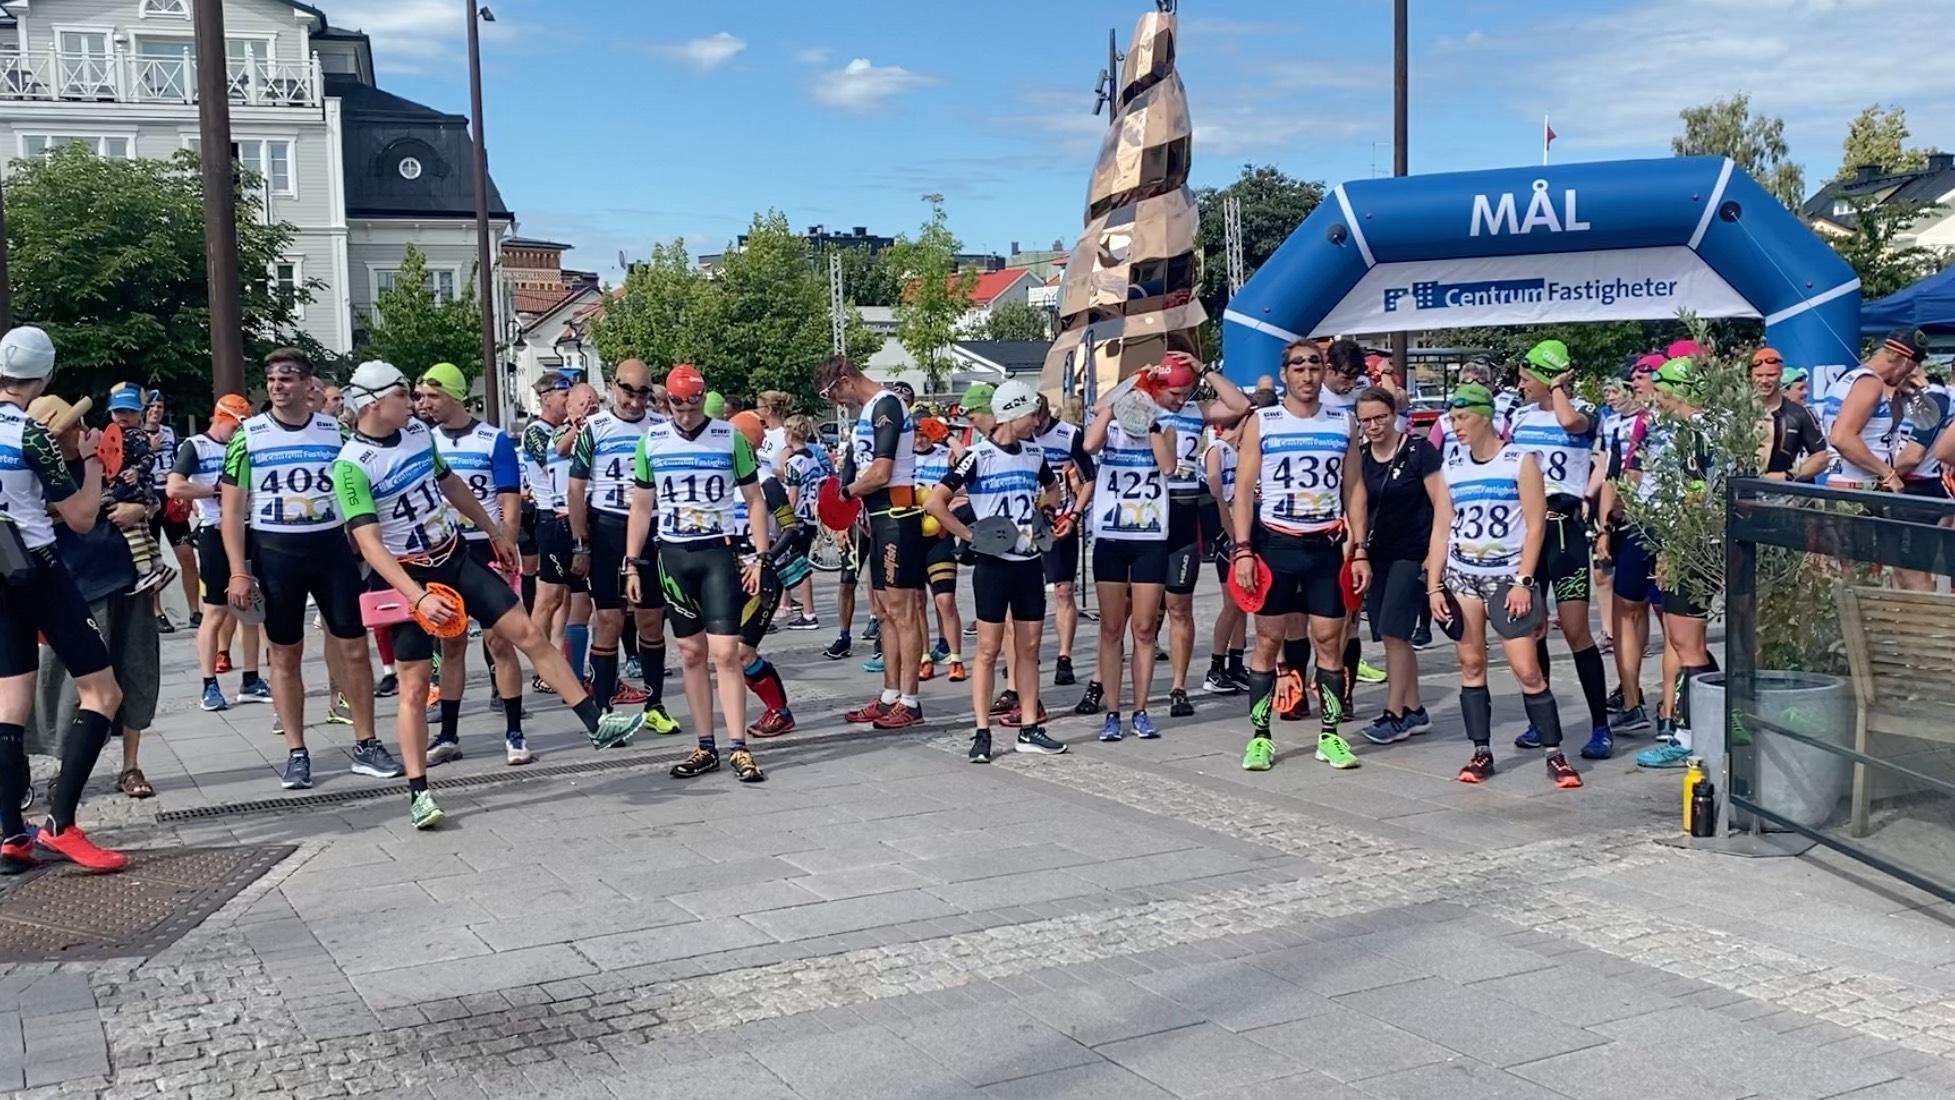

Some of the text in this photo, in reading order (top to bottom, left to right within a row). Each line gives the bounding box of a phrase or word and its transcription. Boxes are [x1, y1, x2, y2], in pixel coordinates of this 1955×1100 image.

[1469, 178, 1591, 237] MÅL
[260, 467, 334, 494] 408
[1107, 470, 1161, 500] 425
[1273, 455, 1341, 489] 438
[660, 474, 725, 503] 410
